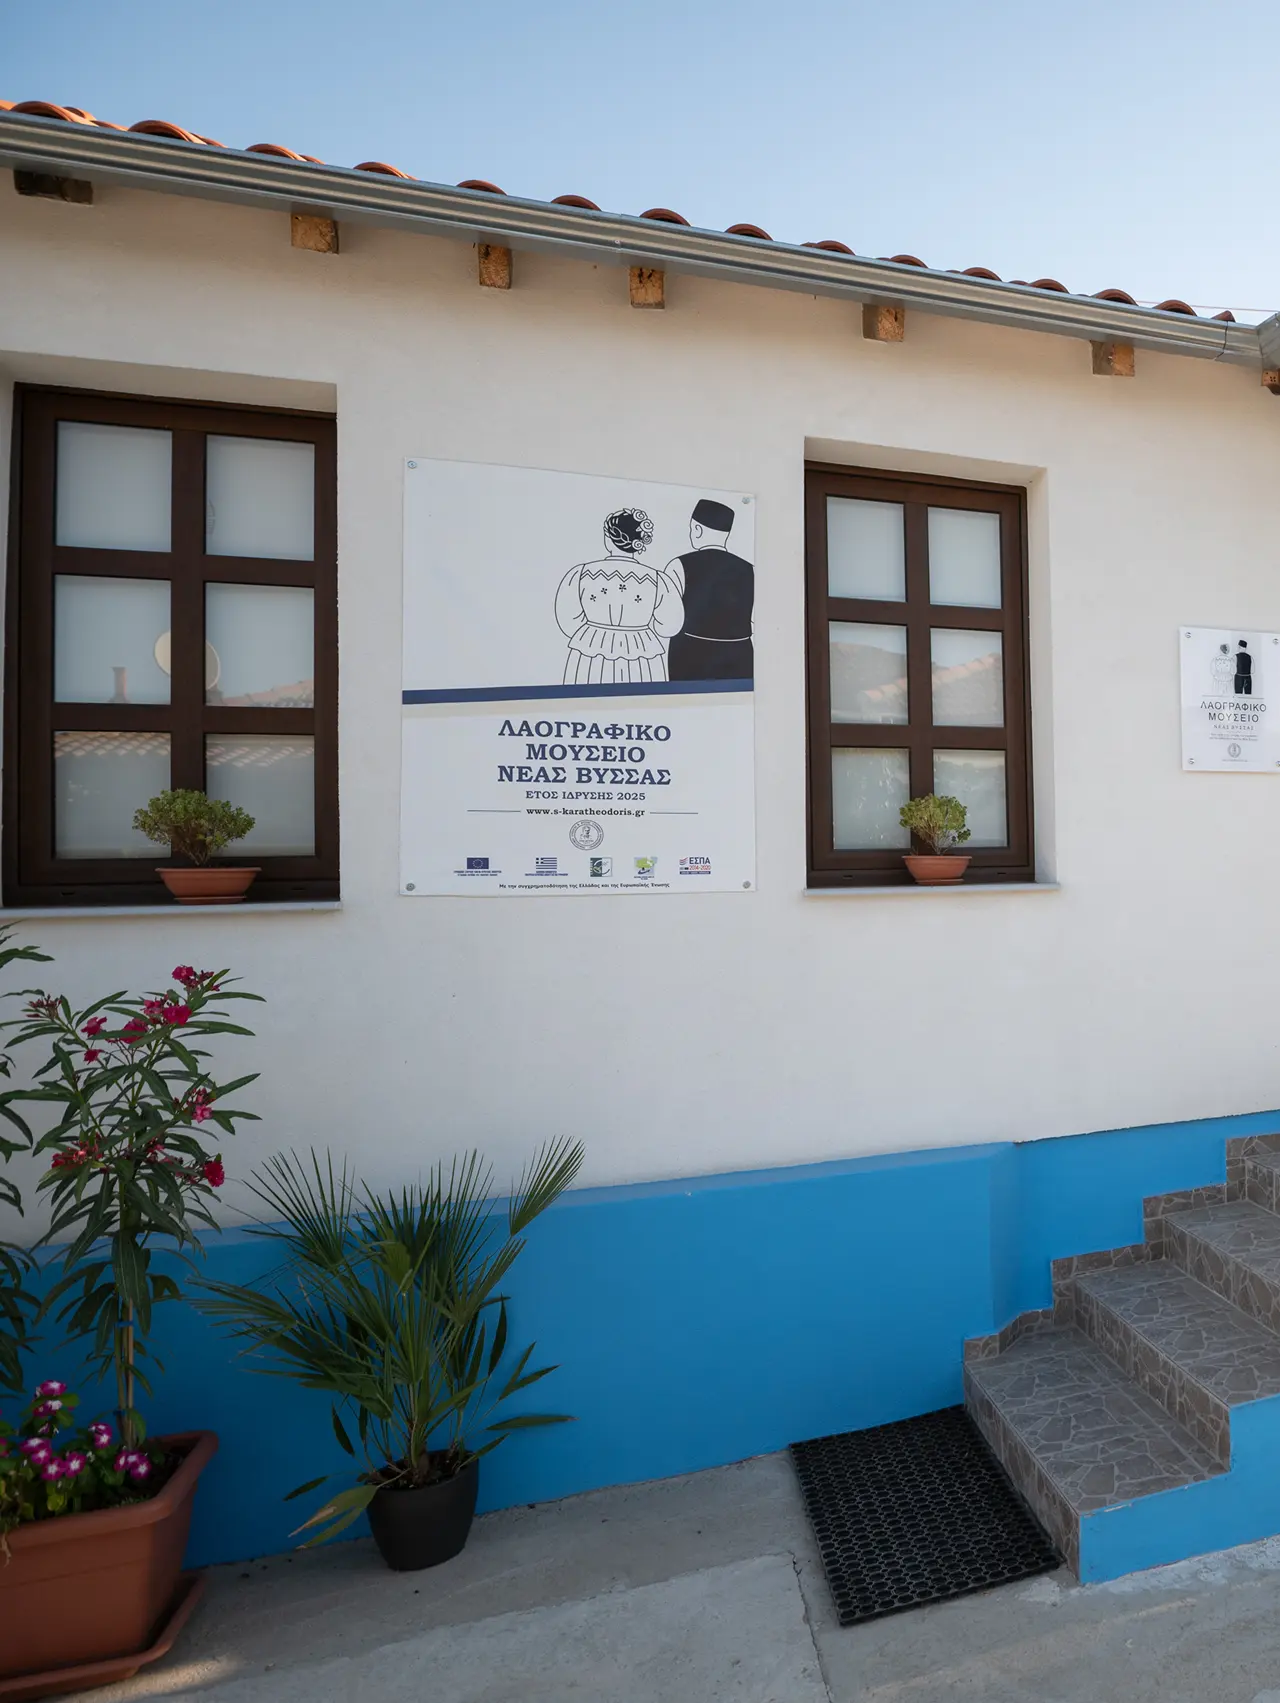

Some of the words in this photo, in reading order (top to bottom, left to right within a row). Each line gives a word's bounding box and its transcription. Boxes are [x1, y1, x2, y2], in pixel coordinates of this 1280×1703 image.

[1200, 701, 1267, 713] ΛΑΟΓΡΑΦΙΚΟ
[1208, 712, 1259, 723] ΜΟΥΣΕΙΟ
[498, 719, 672, 742] ΛΑΟΓΡΑΦΙΚΟ
[525, 743, 646, 763] ΜΟΥΣΕΙΟ
[498, 765, 567, 784] ΝΕΑΣ
[575, 766, 672, 786] ΒΥΣΣΑΣ
[525, 790, 559, 800] ΕΤΟΣ
[562, 791, 614, 801] ΙΔΡΥΣΗΣ
[616, 792, 647, 801] 2025
[526, 807, 646, 818] www.s-karatheodoris.gr
[689, 856, 711, 865] ΕΣΠΑ
